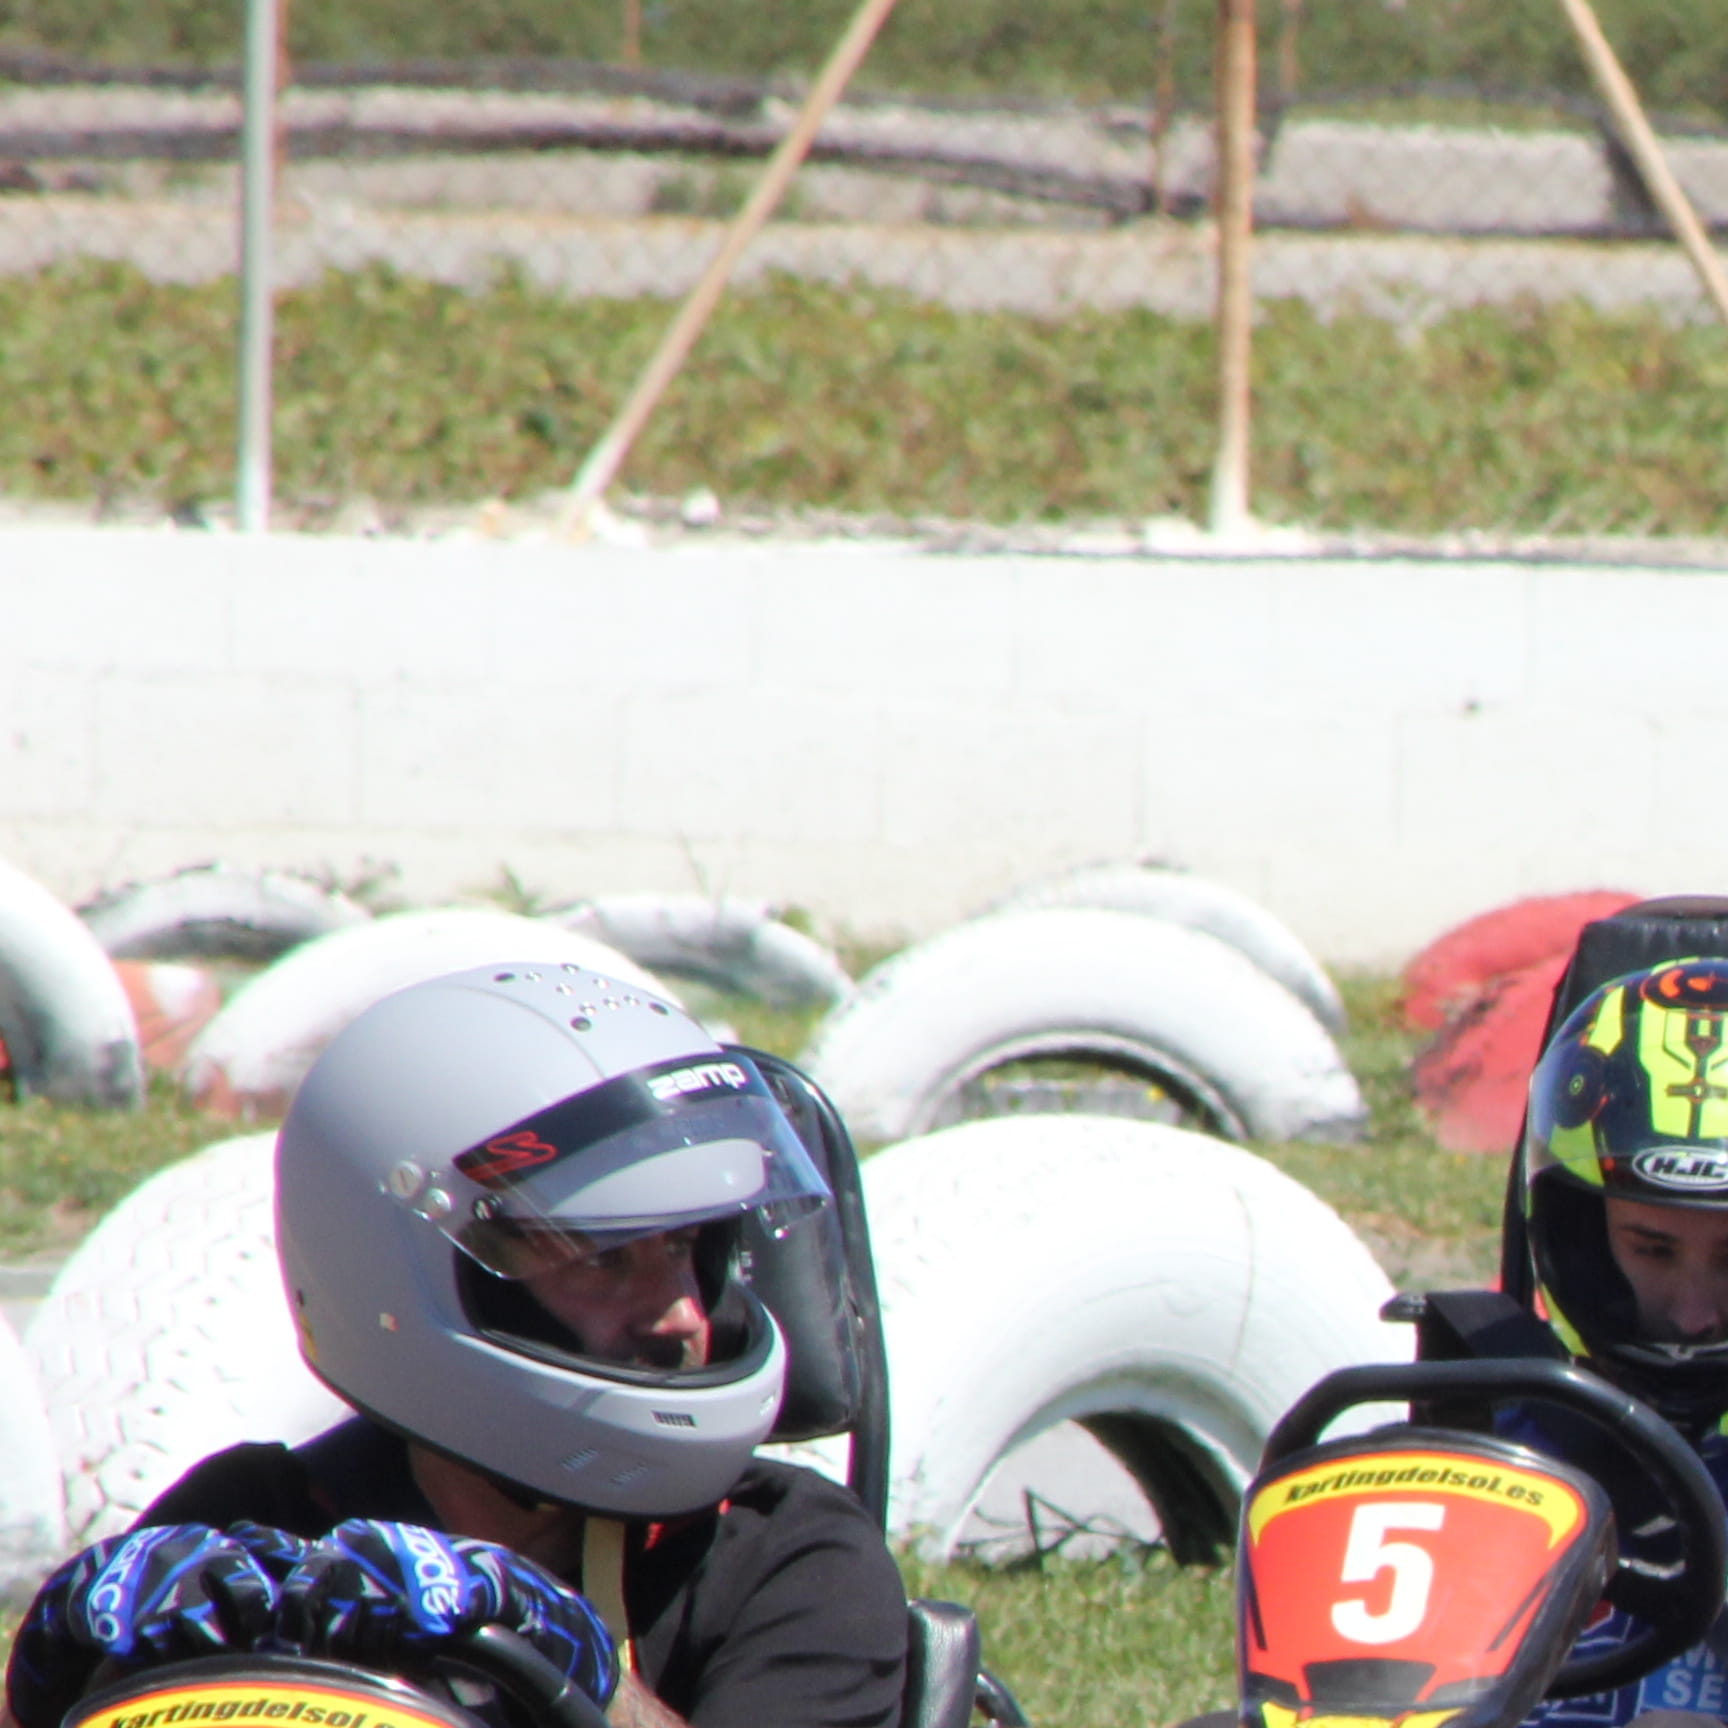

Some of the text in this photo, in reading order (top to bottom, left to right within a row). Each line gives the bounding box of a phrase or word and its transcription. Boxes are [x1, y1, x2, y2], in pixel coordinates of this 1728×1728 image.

[646, 1062, 748, 1101] zamp
[1284, 1464, 1545, 1507] kartingdelsol.es
[1331, 1502, 1445, 1644] 5
